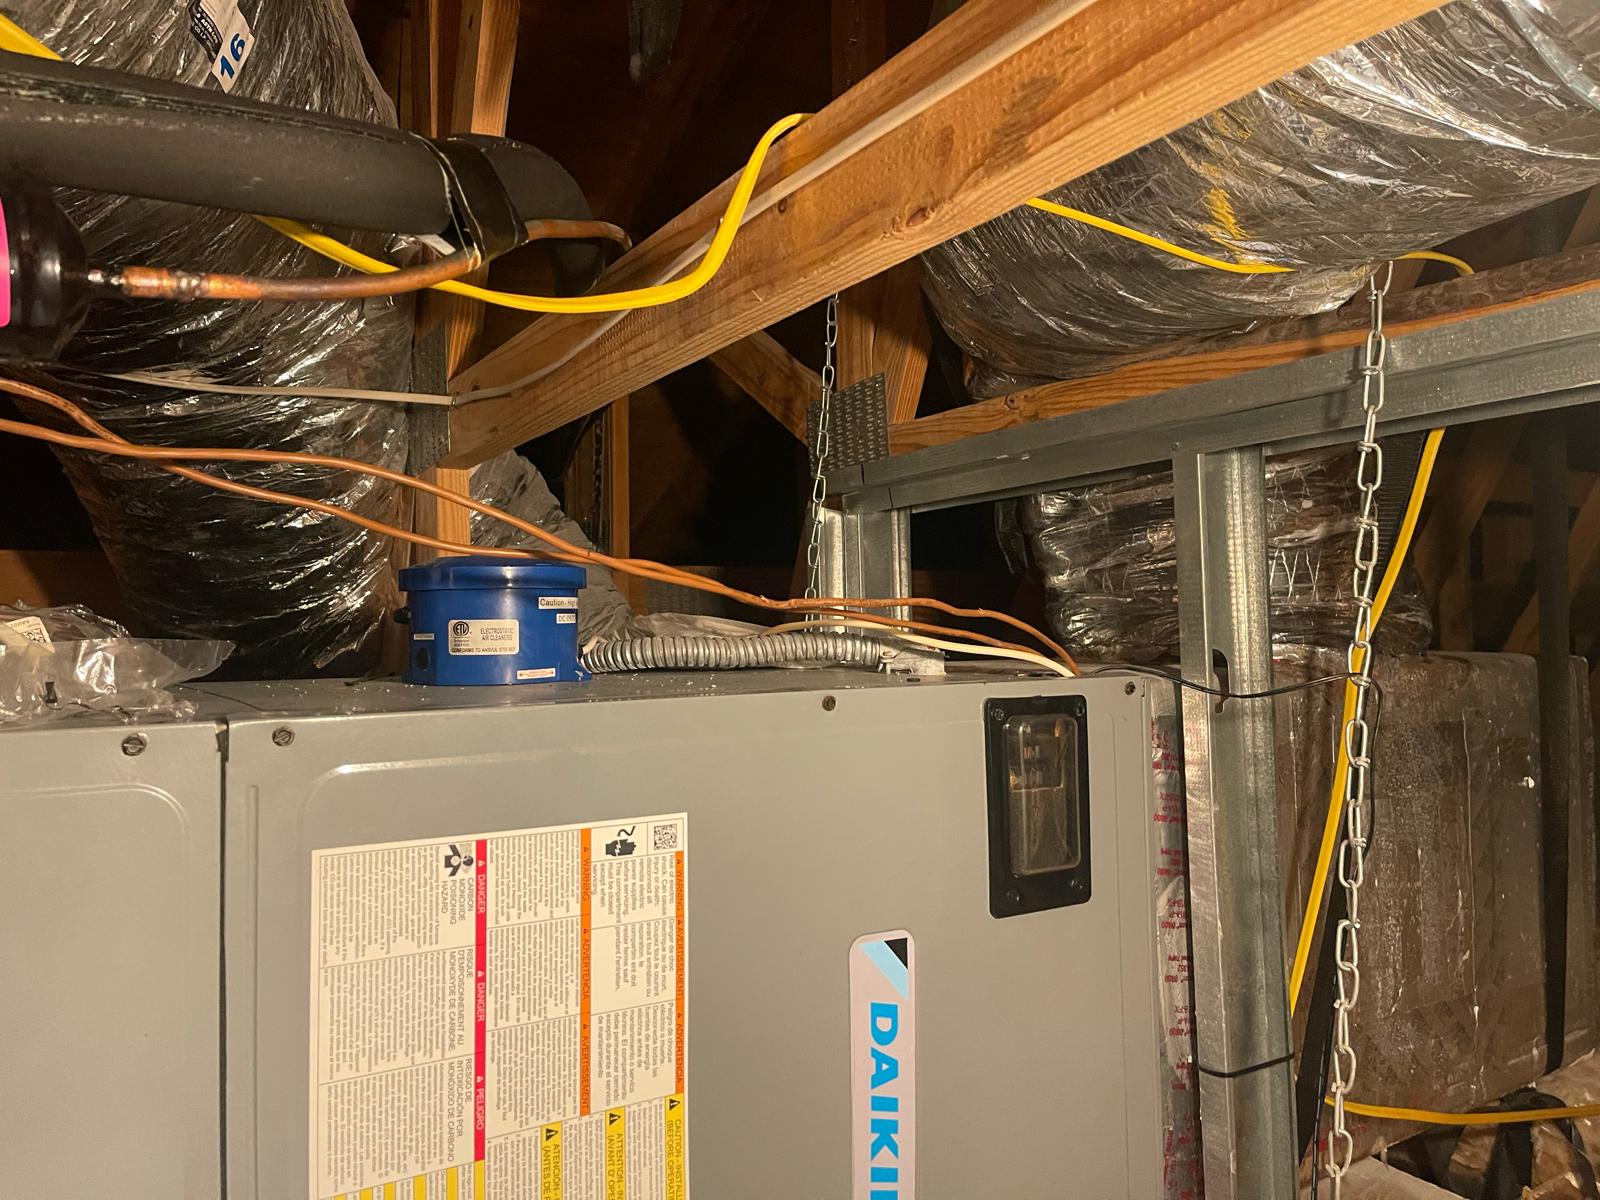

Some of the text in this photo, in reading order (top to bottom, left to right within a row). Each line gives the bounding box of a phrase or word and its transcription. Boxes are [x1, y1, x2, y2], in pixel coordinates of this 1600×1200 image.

[220, 33, 245, 79] 16
[458, 879, 466, 921] MONOXIDE
[478, 874, 486, 913] DANGER
[448, 951, 456, 996] MONOXYDE
[466, 948, 474, 978] RISQUE
[582, 939, 590, 1000] ADVERTENCIA
[477, 982, 485, 1022] DANGER
[448, 1012, 456, 1051] CARBONE
[456, 1120, 464, 1137] POR
[476, 1088, 484, 1130] PELIGRO
[447, 1121, 456, 1161] CARBONO
[553, 1144, 561, 1190] ATENCIÓN
